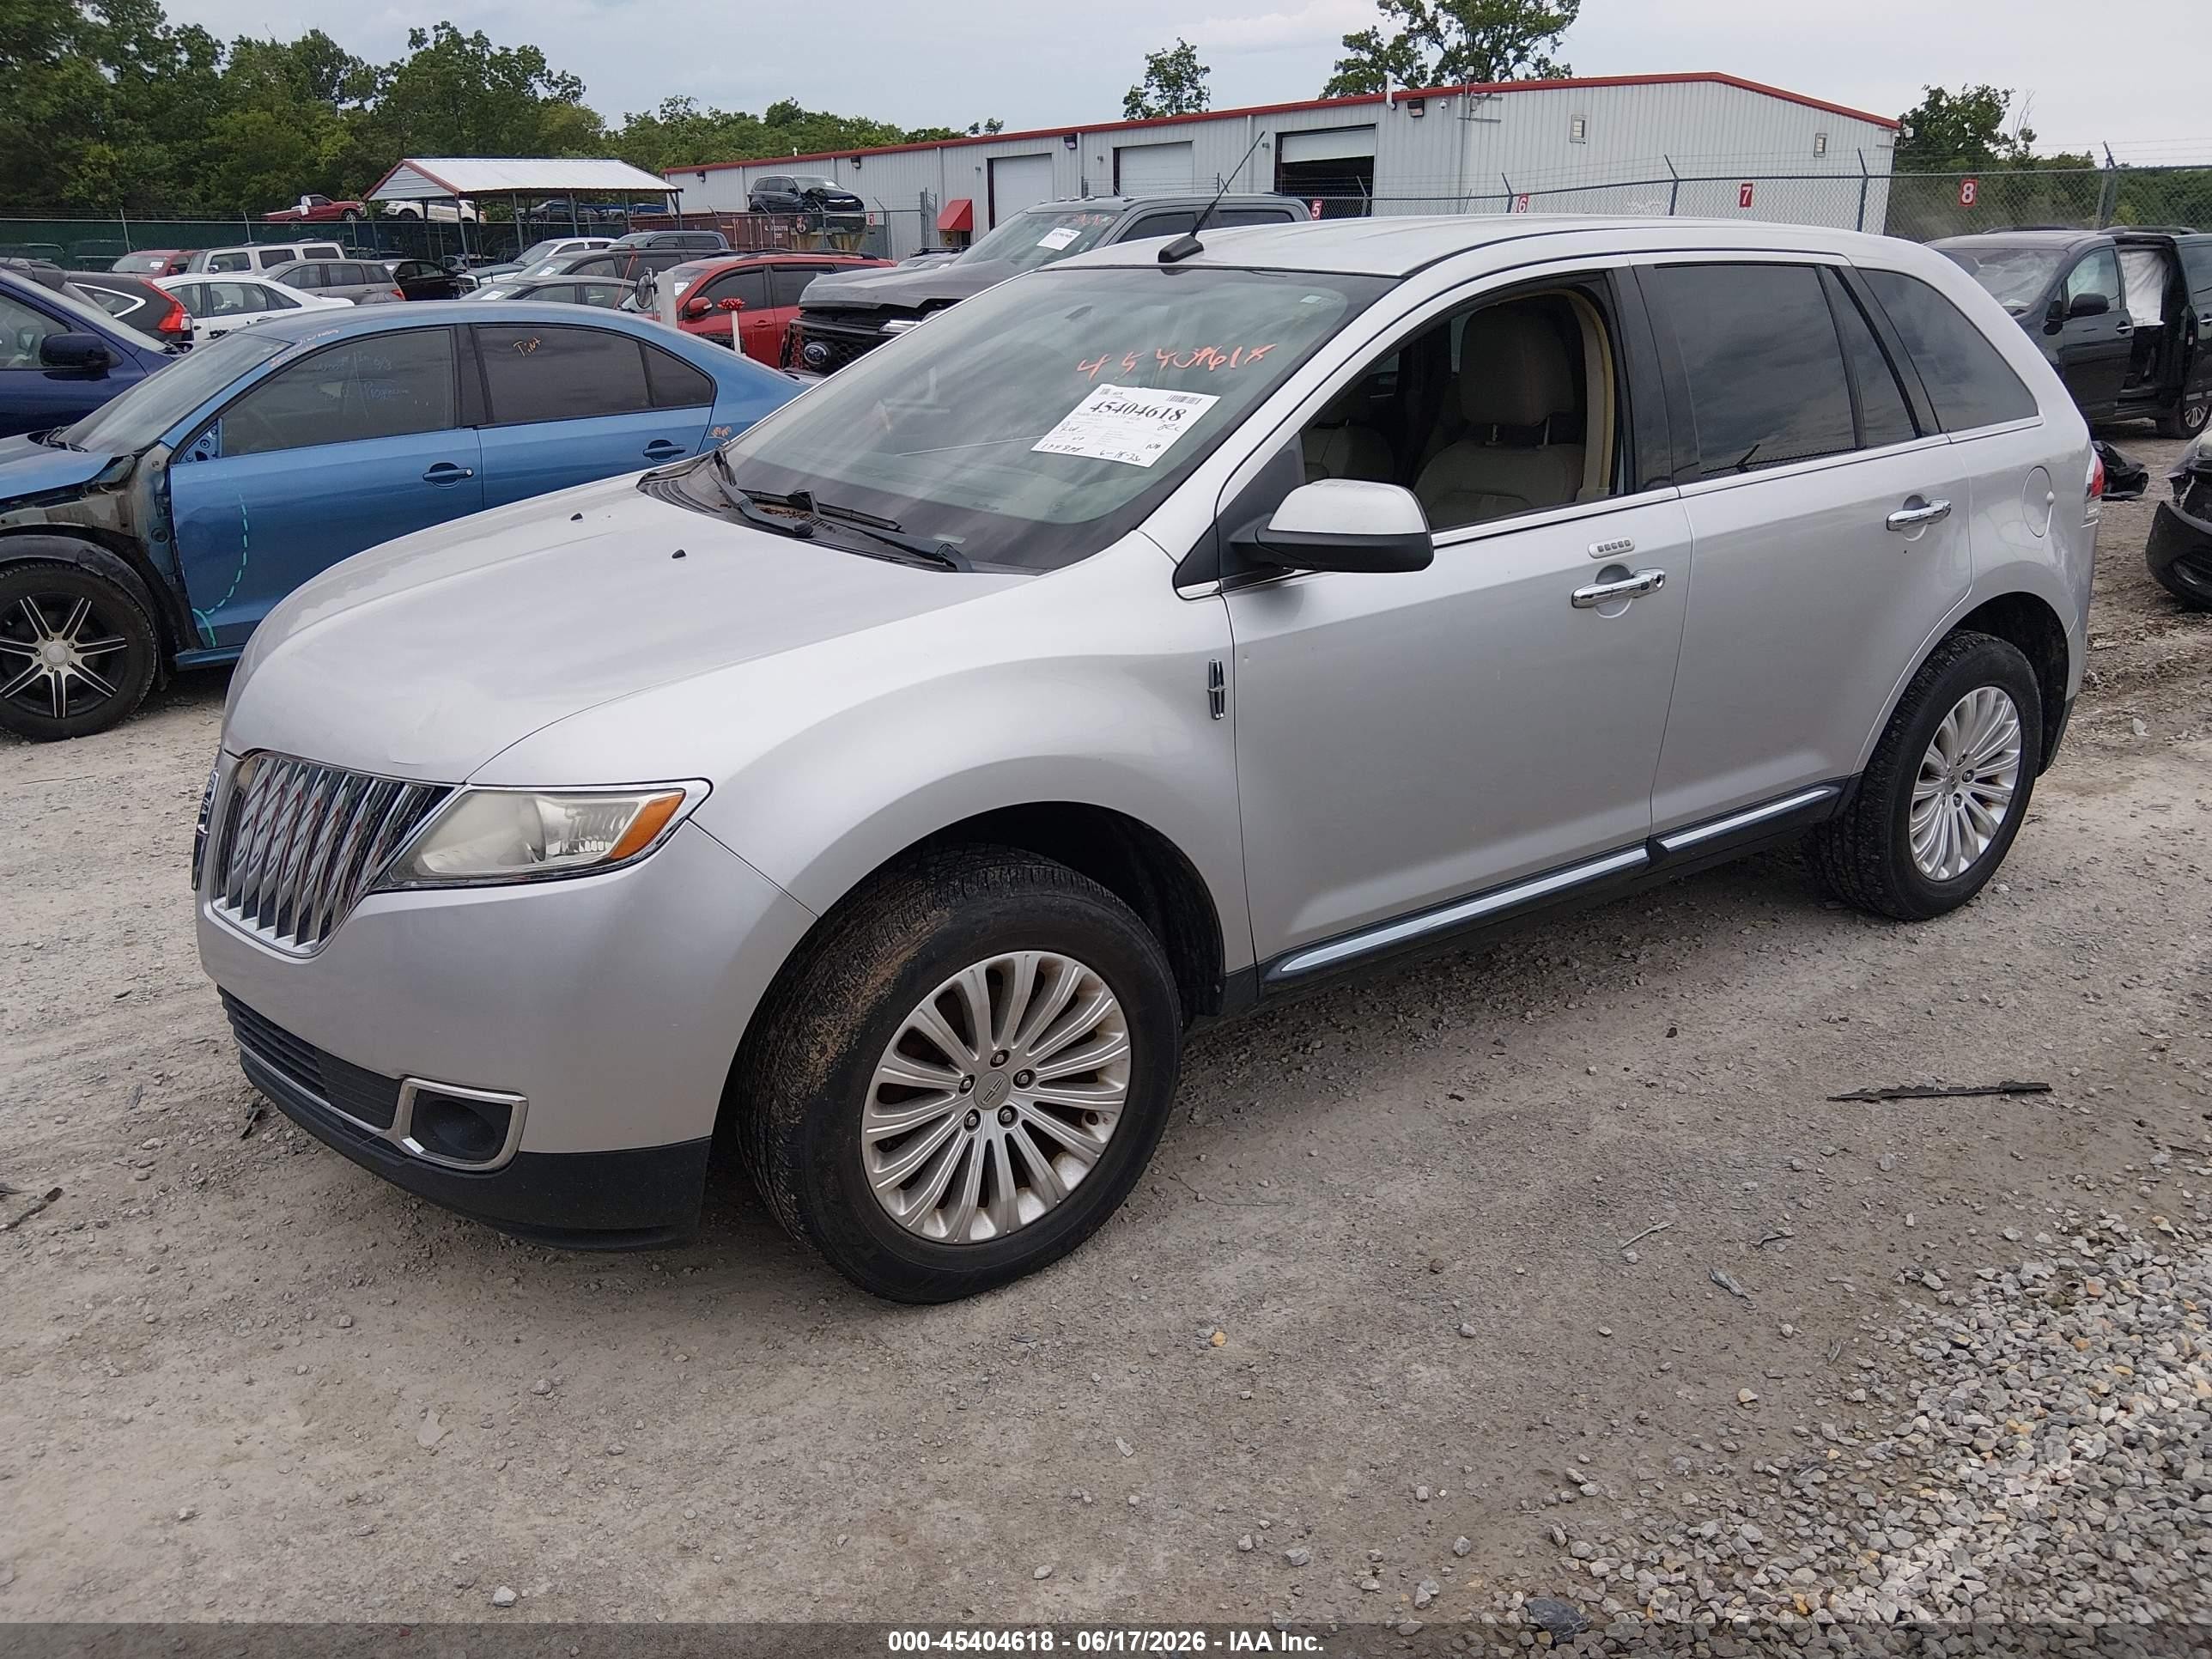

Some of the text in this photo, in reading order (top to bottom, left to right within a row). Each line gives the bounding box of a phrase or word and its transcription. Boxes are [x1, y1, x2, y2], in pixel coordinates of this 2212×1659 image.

[1741, 185, 1752, 205] 7
[1961, 182, 1975, 204] 8
[1311, 203, 1322, 217] 5
[1518, 197, 1528, 213] 6
[1089, 399, 1188, 422] 45404618
